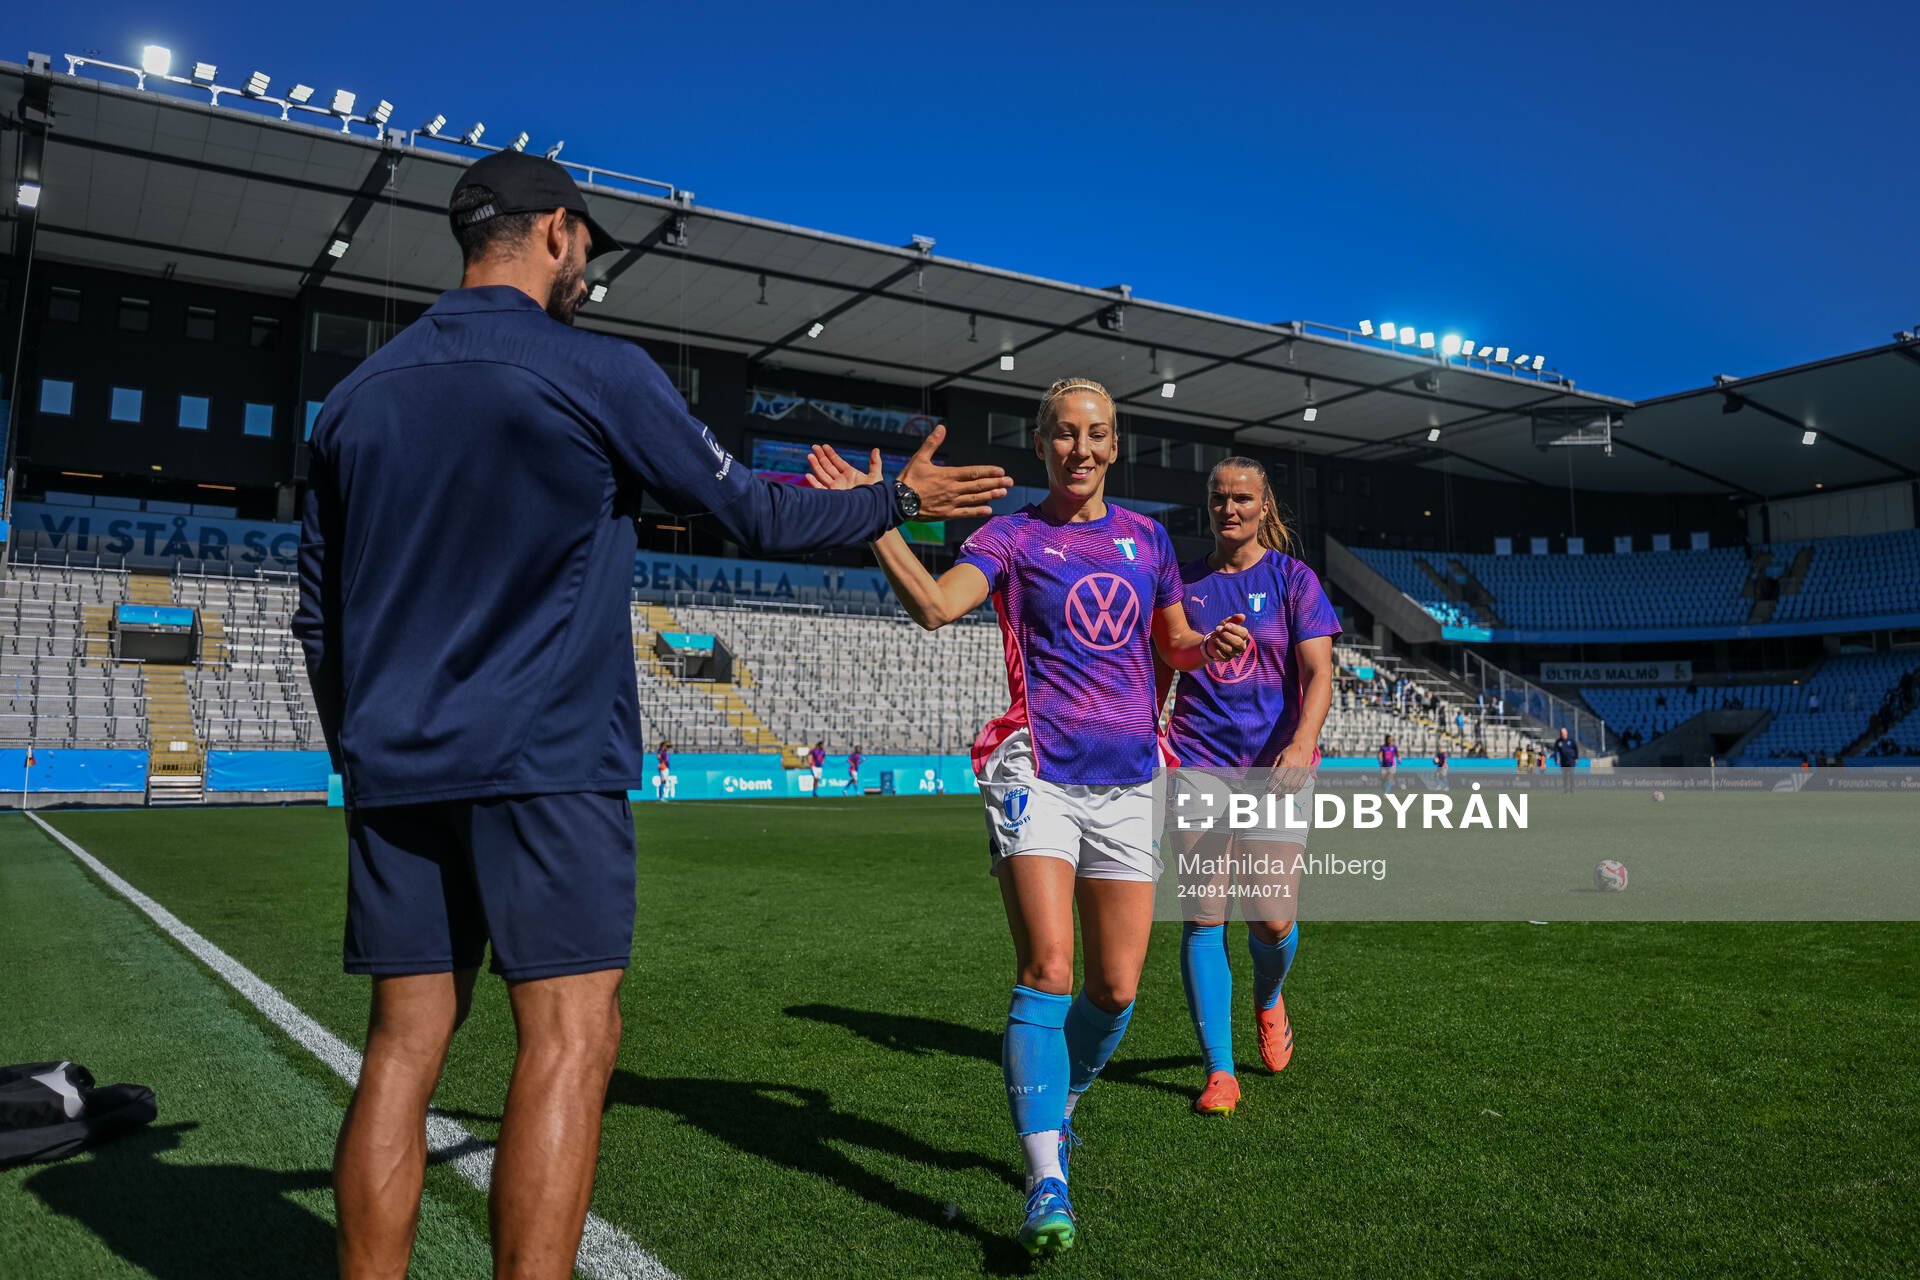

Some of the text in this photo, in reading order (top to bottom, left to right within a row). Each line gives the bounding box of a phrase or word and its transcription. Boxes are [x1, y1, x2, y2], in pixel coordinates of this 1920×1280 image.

[40, 513, 90, 551] VI
[105, 516, 229, 561] STÅR
[708, 566, 795, 599] ALLA
[1634, 778, 1682, 787] information
